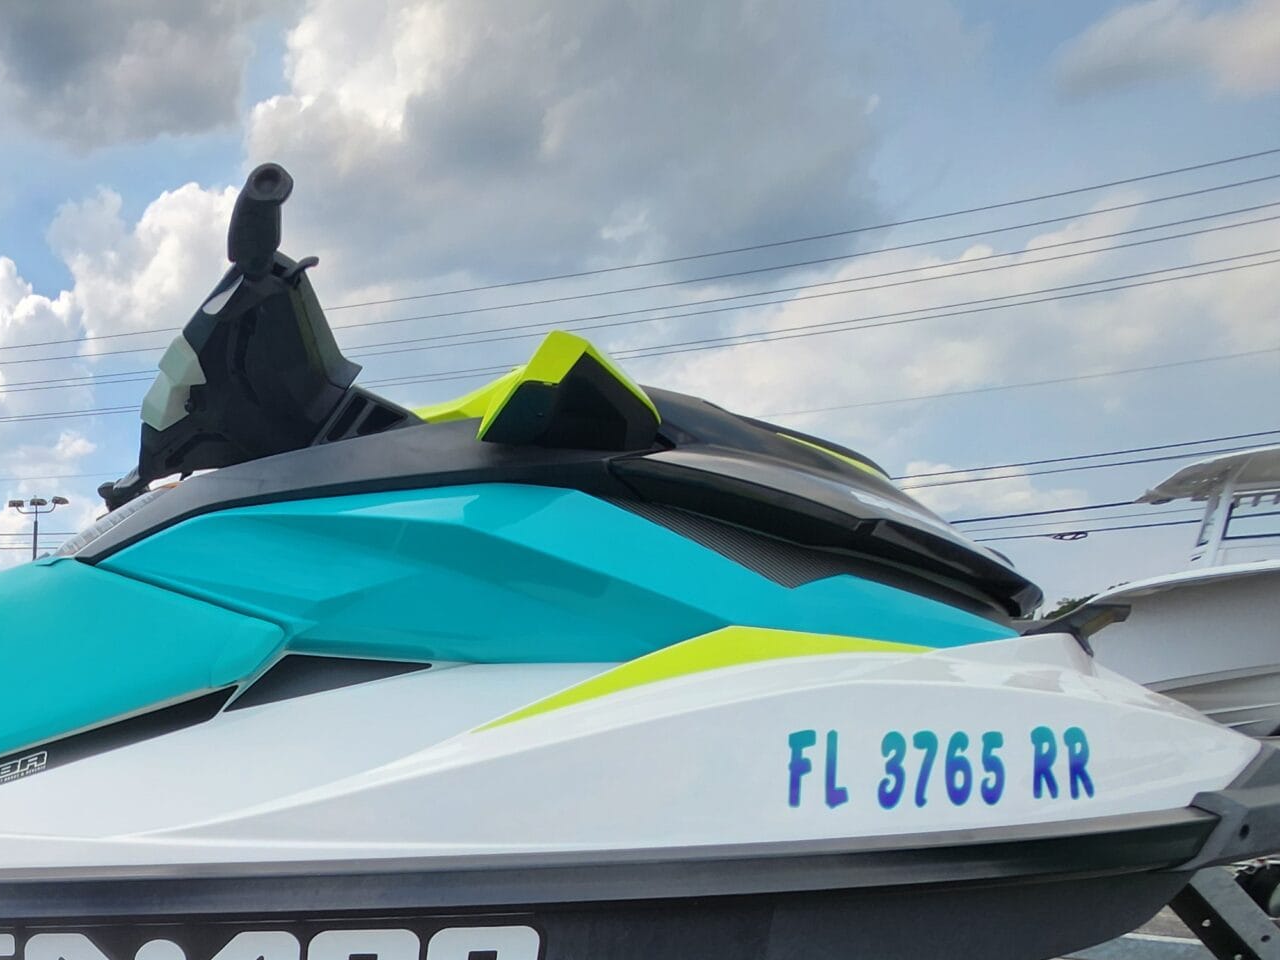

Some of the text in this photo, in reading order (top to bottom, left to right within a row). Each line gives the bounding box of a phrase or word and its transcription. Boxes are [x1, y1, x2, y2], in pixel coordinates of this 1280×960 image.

[788, 726, 1094, 810] FL 3765 RR
